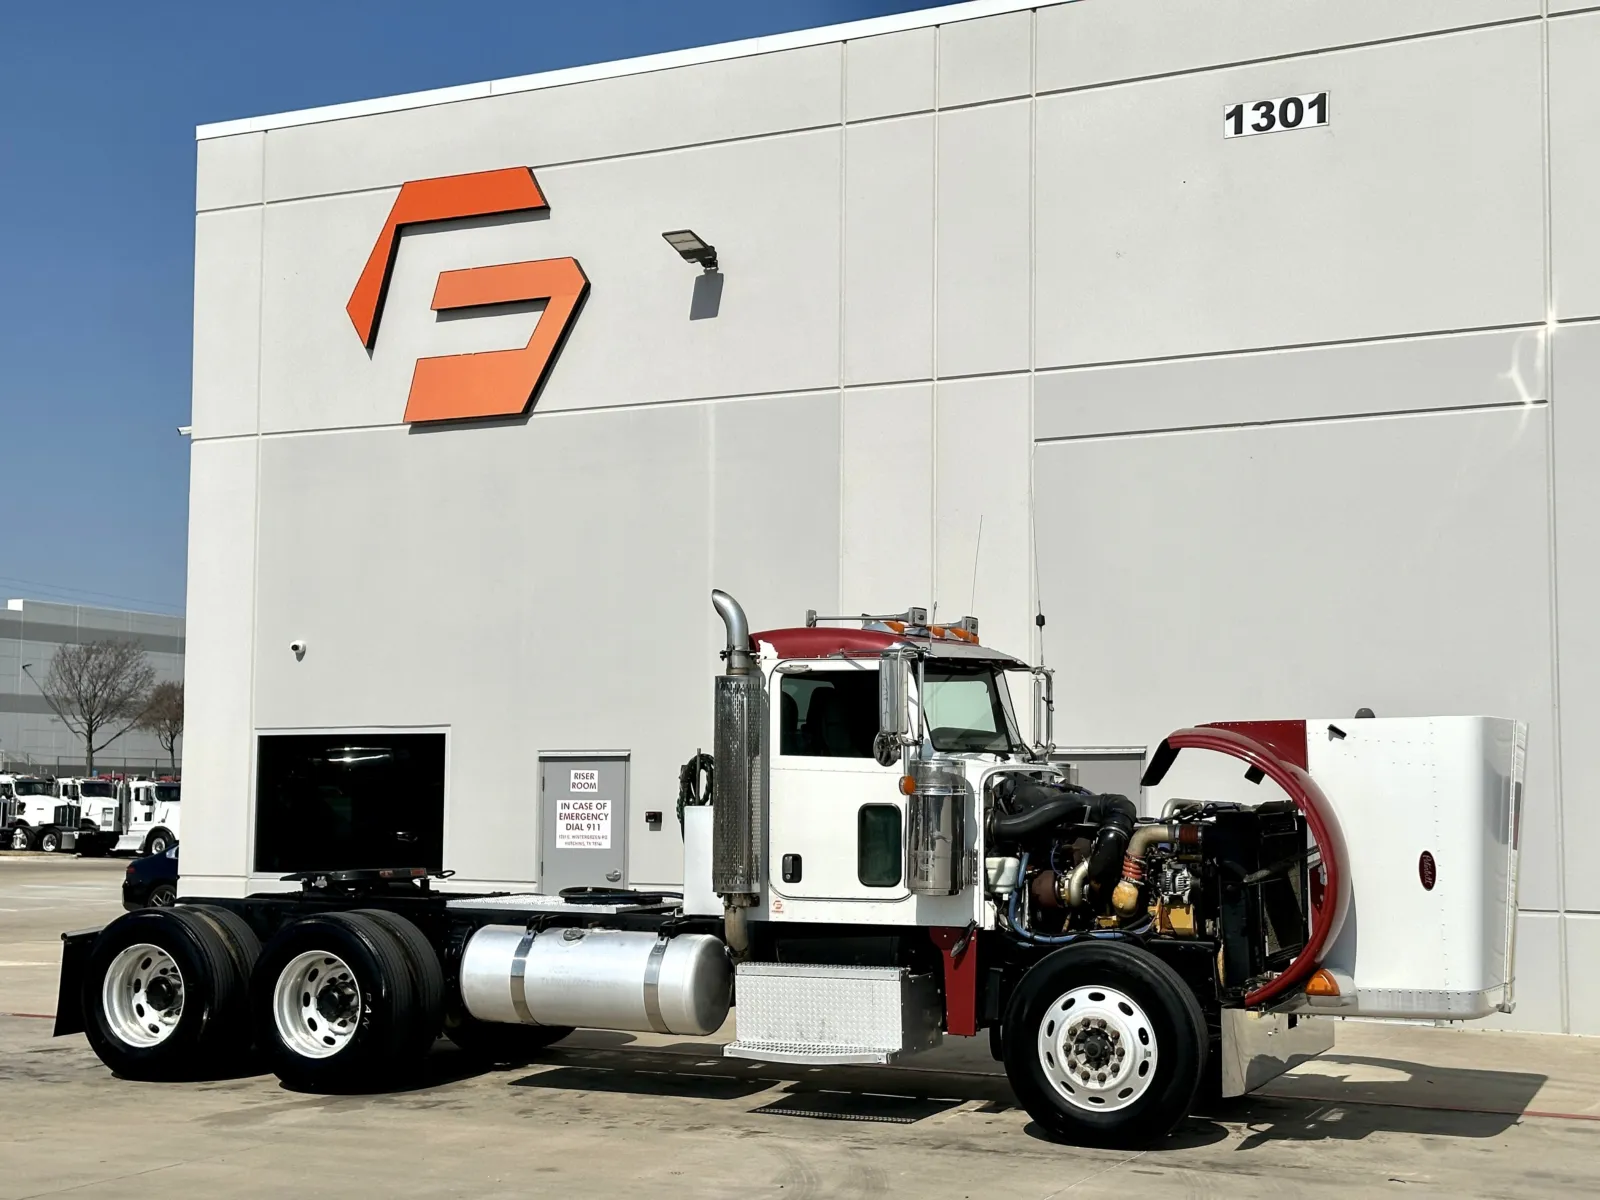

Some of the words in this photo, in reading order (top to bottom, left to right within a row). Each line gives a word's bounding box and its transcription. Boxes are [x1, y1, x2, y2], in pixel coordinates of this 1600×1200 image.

[1226, 92, 1327, 135] 1301
[574, 772, 595, 780] RISER
[571, 782, 597, 790] ROOM
[560, 802, 570, 810] IN
[572, 802, 593, 810] CASE
[595, 802, 607, 810] OF
[559, 812, 609, 821] EMERGENCY
[565, 823, 584, 831] DIAL
[586, 823, 601, 831] 911
